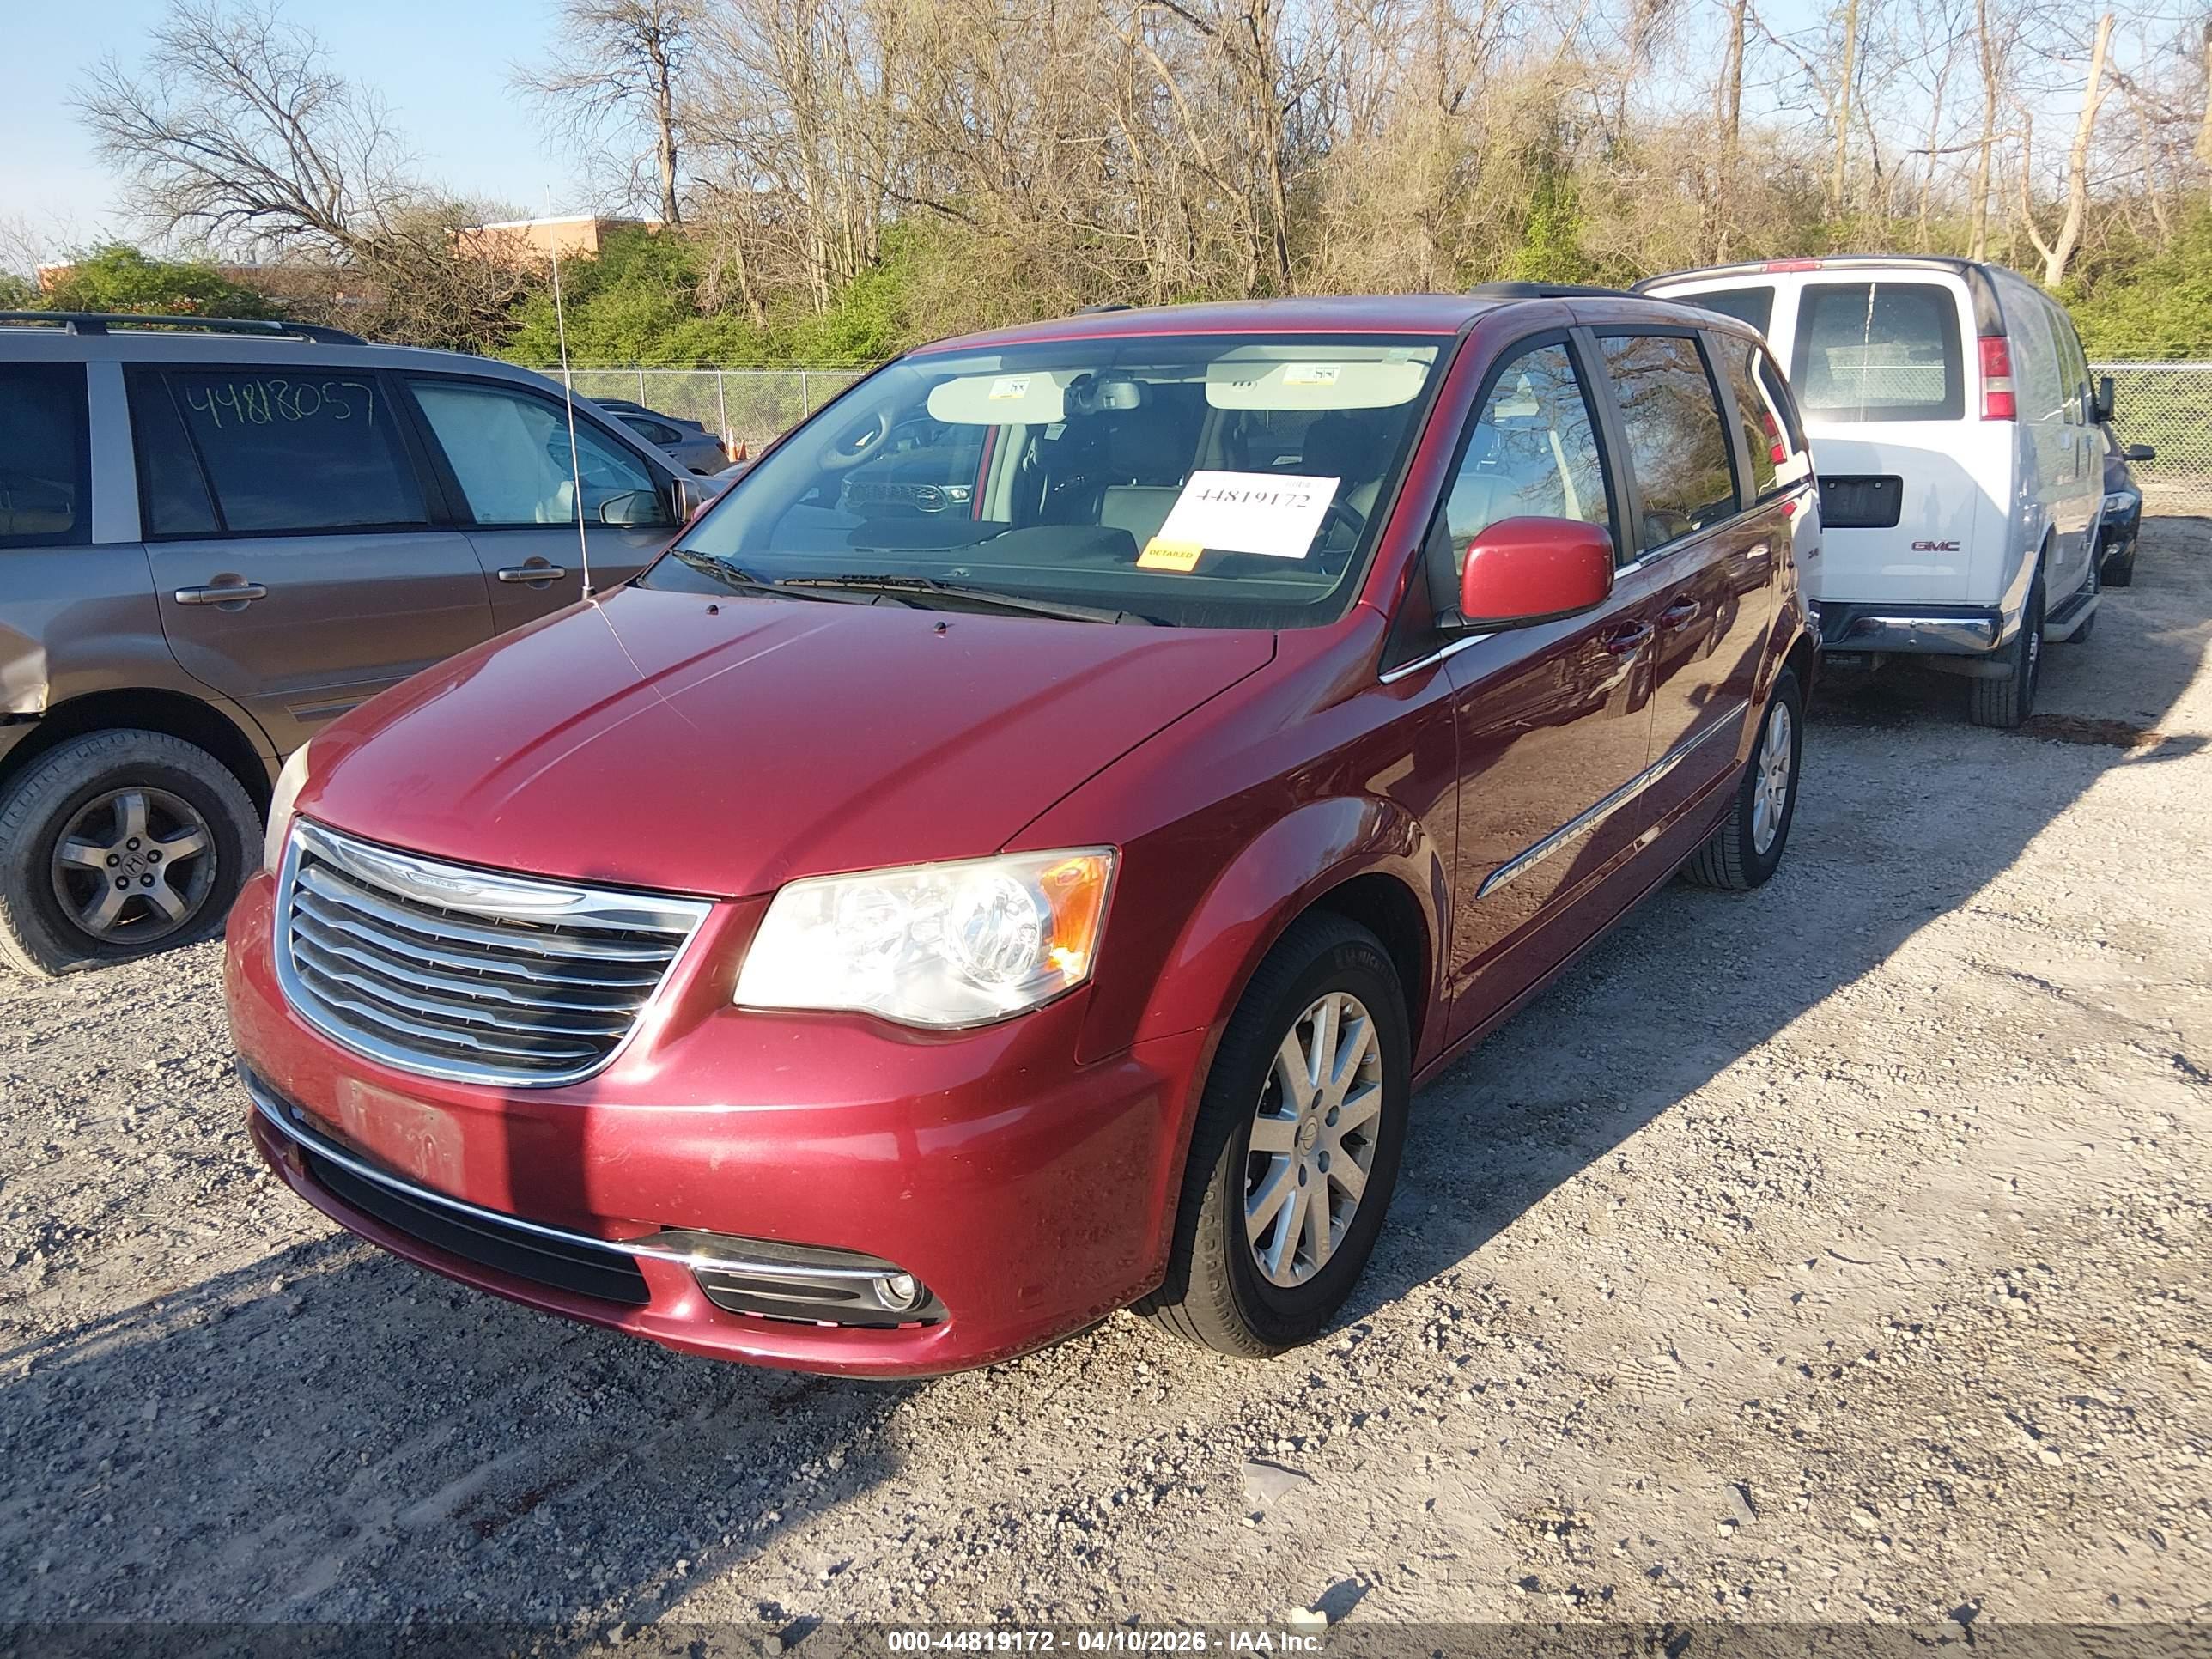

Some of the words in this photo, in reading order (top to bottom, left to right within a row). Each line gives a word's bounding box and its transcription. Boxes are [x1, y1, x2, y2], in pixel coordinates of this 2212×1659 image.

[185, 379, 374, 429] 44818057
[1196, 489, 1311, 508] 44819172
[1911, 541, 1960, 552] GMC
[1149, 550, 1194, 560] DETAILED
